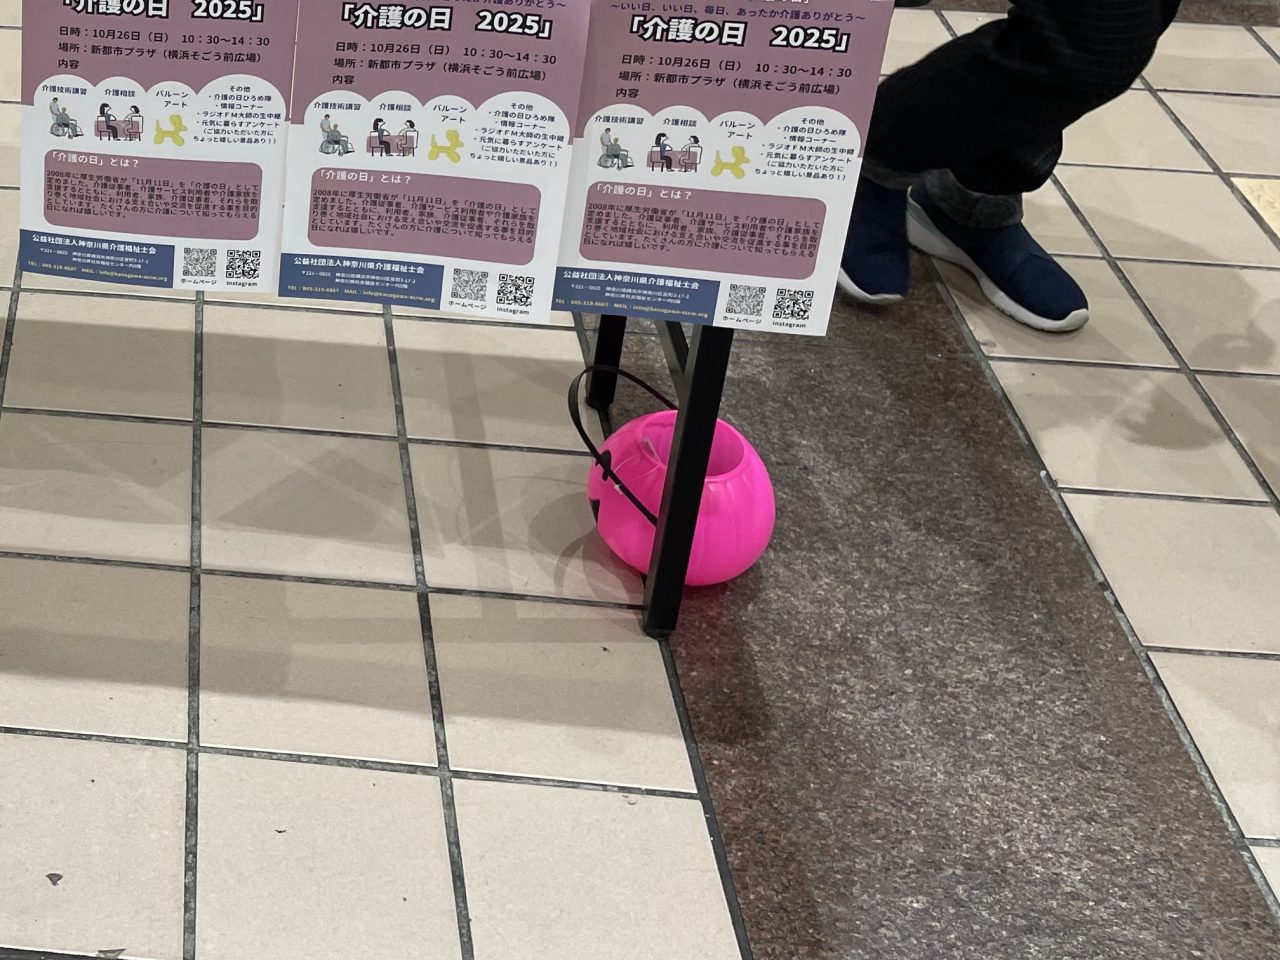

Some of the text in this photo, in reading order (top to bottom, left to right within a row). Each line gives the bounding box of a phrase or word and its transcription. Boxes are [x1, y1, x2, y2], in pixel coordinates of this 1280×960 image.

[342, 2, 553, 40] 「介護の日 2025」
[630, 15, 851, 53] 「介護の日 2025」
[58, 42, 262, 64] 場所：新都市プラザ（横浜そごう前広場）
[57, 59, 80, 70] 内容
[333, 57, 547, 82] 場所：新都市プラザ（横浜そごう前広場）
[332, 74, 355, 85] 内容
[618, 71, 841, 96] 場所：新都市プラザ（横浜そごう前広場）
[41, 84, 87, 96] 介護技術講習
[104, 88, 136, 97] 介護相談
[155, 89, 189, 99] バルーン
[229, 85, 251, 93] その他
[615, 88, 640, 99] 内容
[163, 101, 188, 109] アート
[313, 101, 361, 111] 介護技術講習
[379, 103, 412, 112] 介護相談
[432, 104, 468, 114] バルーン
[510, 102, 533, 111] その他
[440, 115, 465, 124] アート
[594, 115, 645, 126] 介護技術講習
[662, 117, 697, 128] 介護相談
[719, 120, 756, 129] バルーン
[801, 117, 825, 126] その他
[726, 130, 753, 140] アート
[32, 234, 156, 255] 公益社団法人神奈川県介護福祉士会
[294, 257, 425, 274] 公益社団法人神奈川県介護福祉士会
[564, 270, 699, 290] 公益社団法人神奈川県介護福祉士会
